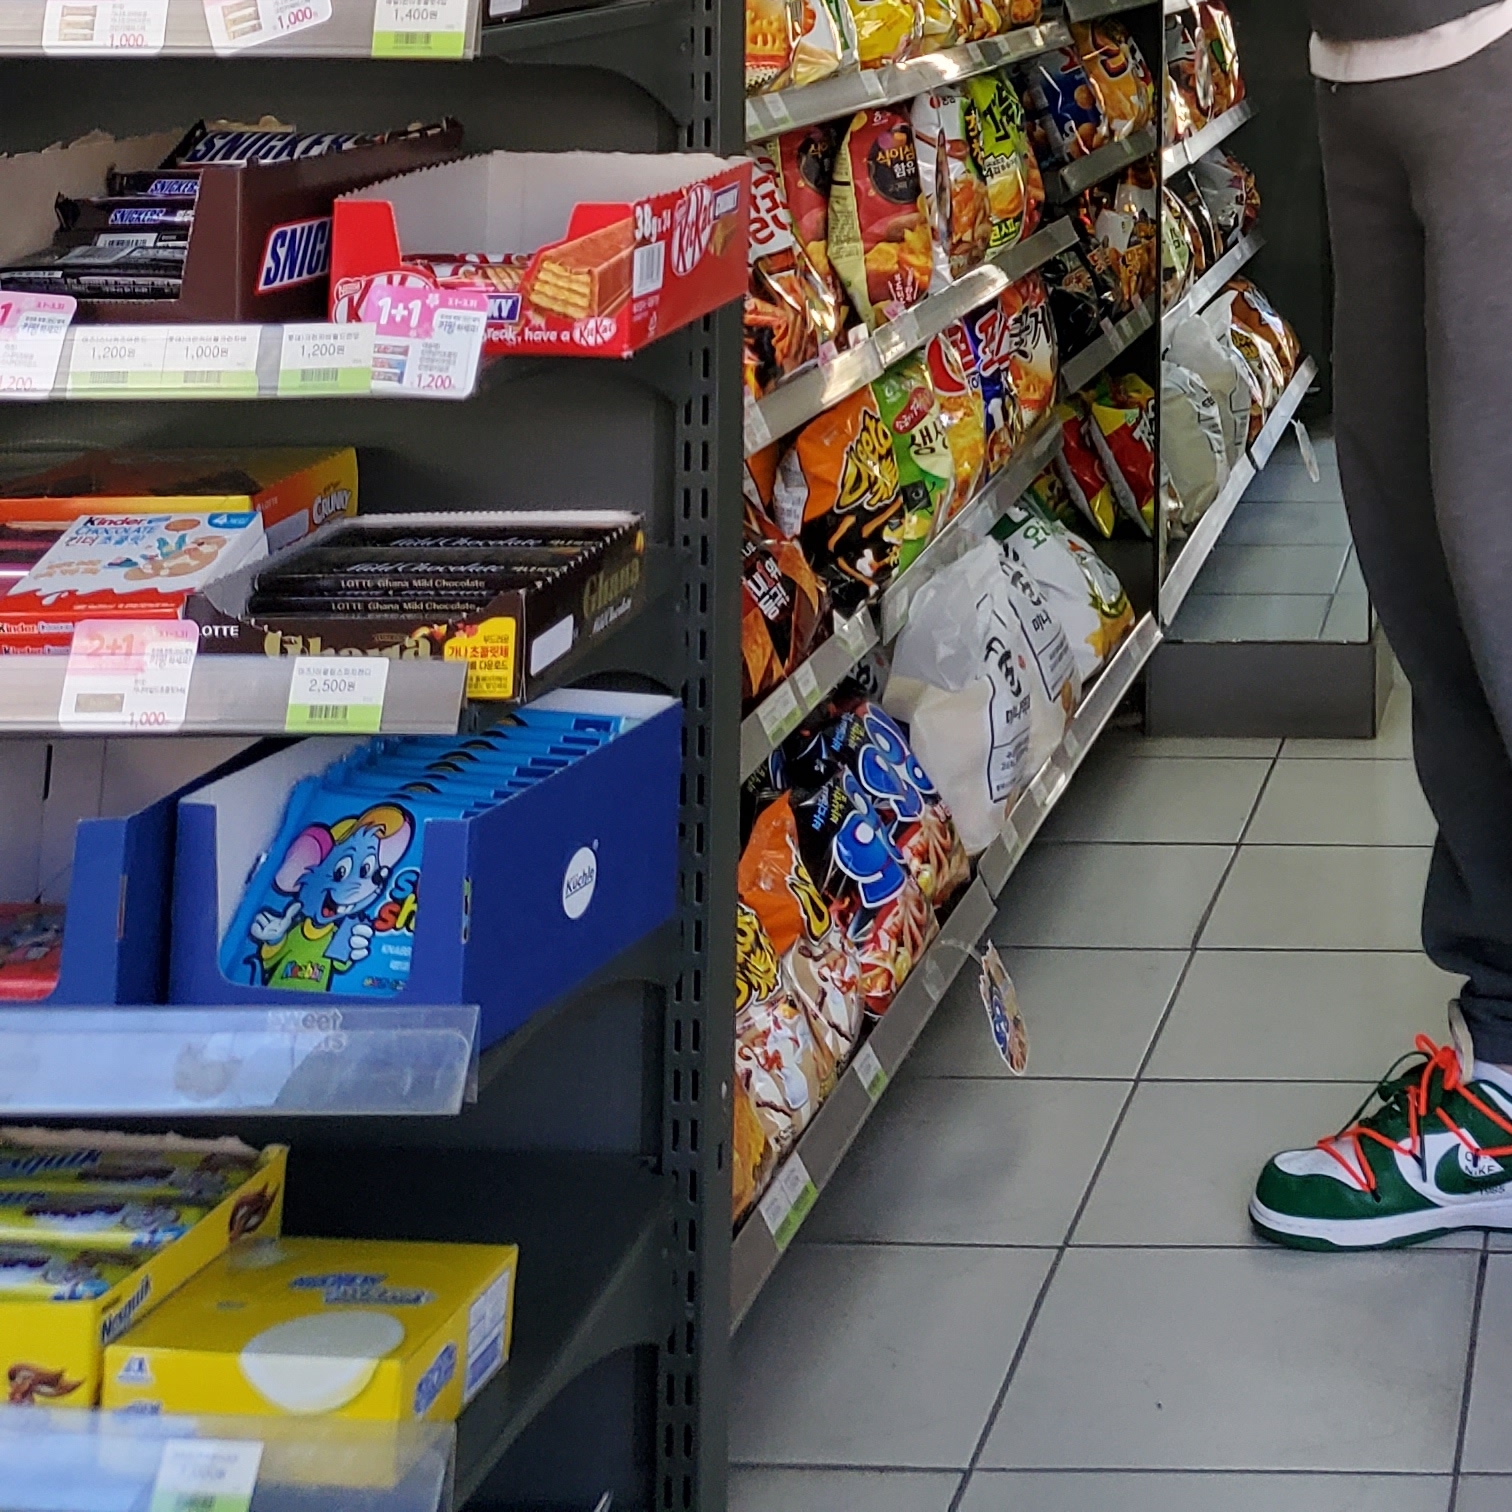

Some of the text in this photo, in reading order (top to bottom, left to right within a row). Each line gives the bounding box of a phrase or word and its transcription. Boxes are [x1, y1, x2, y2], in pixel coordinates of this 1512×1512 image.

[276, 6, 314, 30] 1,000
[393, 7, 438, 21] 1,400원
[109, 33, 145, 49] 1,000
[110, 208, 165, 224] SNICKERS
[377, 298, 424, 328] 1+1
[524, 327, 557, 344] have
[560, 332, 570, 343] a
[575, 318, 615, 346] KitKat
[91, 346, 136, 359] 1,200원
[183, 346, 229, 359] 1,000원
[300, 344, 345, 357] 1,200원
[415, 373, 453, 390] 1,200
[86, 516, 147, 527] Kinder
[377, 579, 409, 589] Ghana
[412, 578, 433, 589] Mild
[435, 578, 486, 589] Chocolate
[85, 633, 135, 656] 2+1
[309, 678, 355, 693] 2,500원
[128, 711, 166, 729] 1,000
